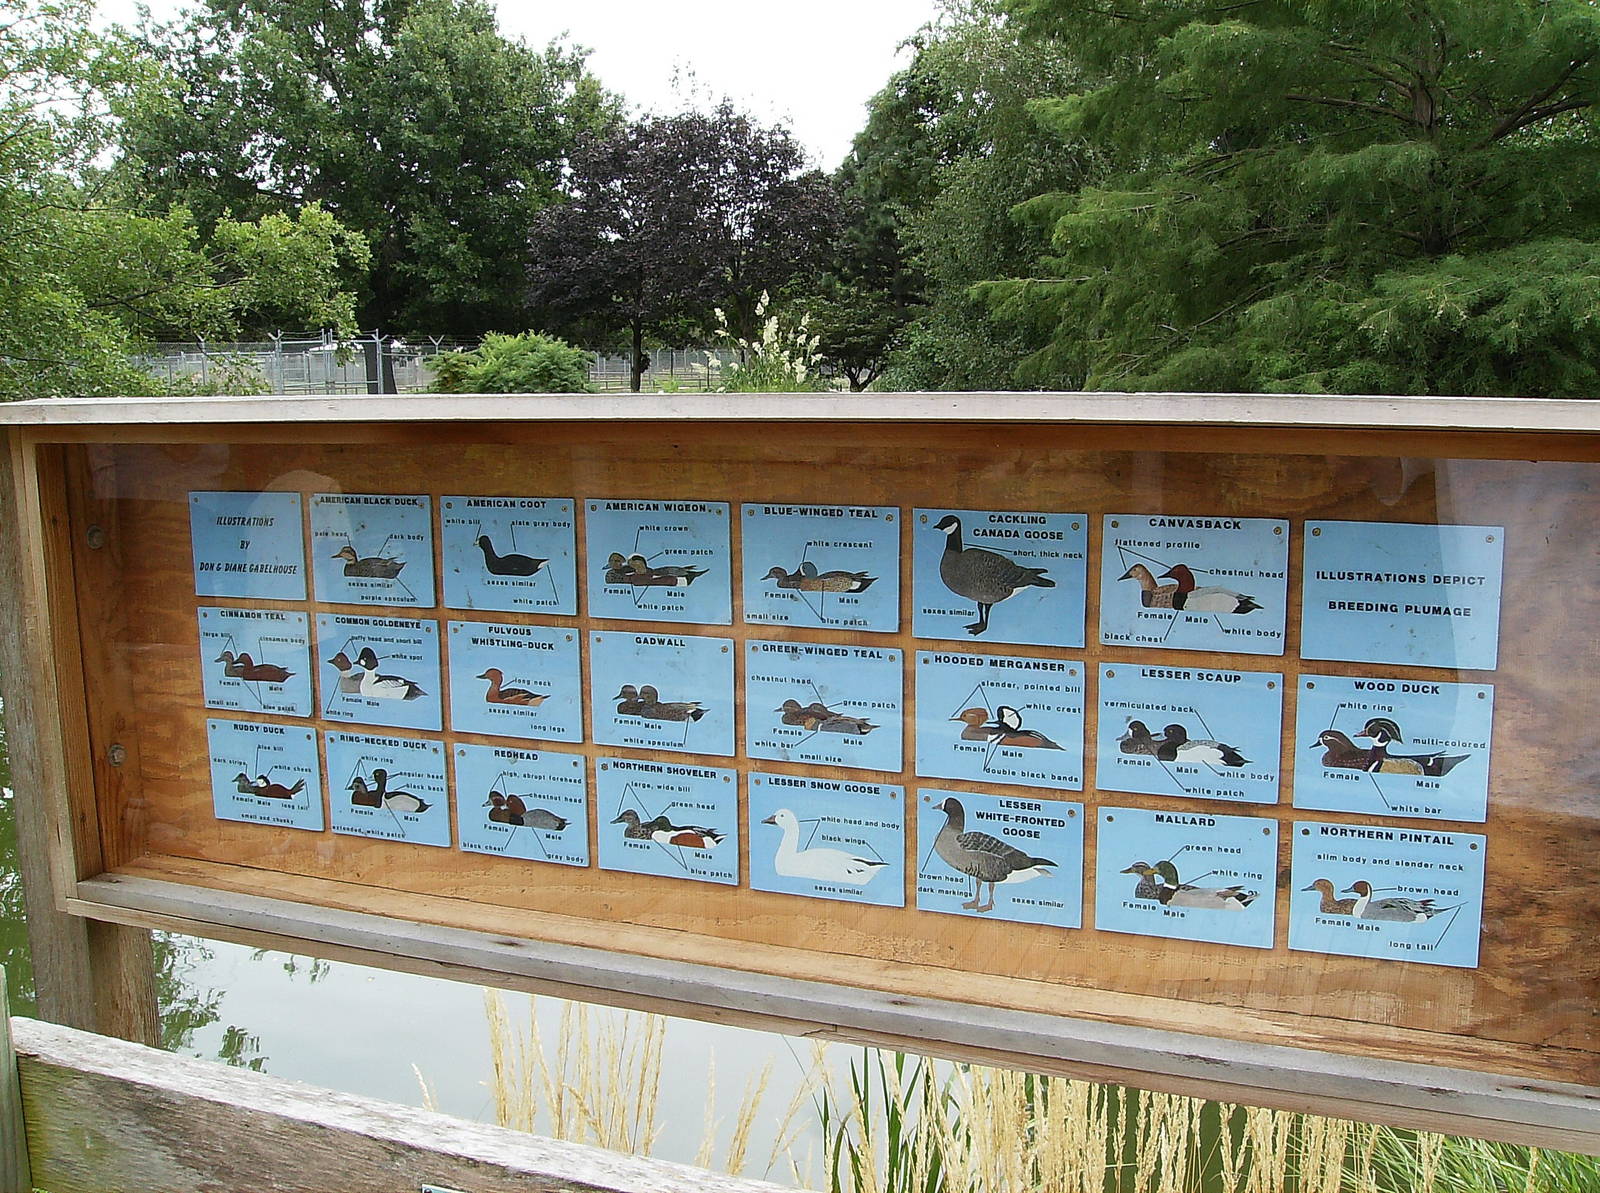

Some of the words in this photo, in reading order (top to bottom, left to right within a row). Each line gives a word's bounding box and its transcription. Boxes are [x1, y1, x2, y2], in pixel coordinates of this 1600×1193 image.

[320, 496, 361, 504] AMERICAN
[467, 500, 516, 508] AMERICAN
[520, 500, 546, 509] COOT
[606, 503, 659, 512] AMERICAN
[664, 504, 706, 512] WIGEON
[764, 507, 843, 517] BLUE-WINGED
[849, 509, 878, 518] TEAL
[216, 517, 274, 527] ILLUSTRATIONS
[989, 515, 1046, 524] CACKLING
[1149, 519, 1241, 530] CANVASBACK
[973, 529, 1020, 538] CANADA
[1025, 531, 1063, 540] GOOSE
[240, 541, 250, 549] BY
[1115, 539, 1161, 548] flattened
[1166, 540, 1200, 549] profile
[200, 562, 215, 571] DON
[225, 564, 247, 572] DIANE
[249, 564, 297, 574] GABELHOUSE
[1209, 568, 1253, 577] chestnut
[1259, 570, 1283, 578] head
[1316, 571, 1426, 584] ILLUSTRATIONS
[1433, 575, 1485, 585] DEPICT
[1328, 601, 1398, 613] BREEDING
[1405, 605, 1471, 617] PLUMAGE
[220, 611, 261, 619] CINNAMON
[265, 612, 285, 621] TEAL
[1138, 612, 1172, 620] Female
[1185, 616, 1208, 624] Male
[336, 617, 369, 626] COMMON
[373, 619, 421, 629] GOLDENEYE
[489, 627, 531, 636] FULVOUS
[1224, 628, 1251, 636] white
[1257, 629, 1281, 638] body
[636, 637, 685, 647] GADWALL
[1105, 633, 1130, 641] black
[1136, 634, 1163, 643] chest
[472, 638, 554, 650] WHISTLING-DUCK
[762, 644, 848, 657] GREEN-WINGED
[854, 650, 882, 659] TEAL
[935, 655, 983, 666] HOODED
[990, 660, 1065, 672] MERGANSER
[751, 675, 787, 683] chestnut
[1142, 669, 1190, 680] LESSER
[1197, 673, 1241, 683] SCAUP
[981, 681, 1020, 690] slender,
[1024, 683, 1060, 692] pointed
[1065, 685, 1081, 693] bill
[1354, 681, 1395, 692] WOOD
[1402, 683, 1440, 694] DUCK
[843, 700, 867, 708] green
[872, 701, 896, 709] patch
[1105, 700, 1167, 711] vermiculated
[1171, 705, 1194, 713] back
[1340, 702, 1368, 710] white
[1373, 703, 1393, 712] ring
[1057, 706, 1081, 714] crest
[614, 718, 641, 726] Female
[644, 722, 662, 730] Male
[234, 724, 259, 732] RUDDY
[263, 726, 284, 734] DUCK
[773, 728, 802, 737] Female
[340, 735, 399, 747] RING-NECKED
[403, 740, 427, 750] DUCK
[844, 738, 863, 746] Male
[1413, 737, 1486, 749] multi-colored
[954, 744, 985, 753] Female
[494, 750, 538, 761] REDHEAD
[1002, 750, 1023, 758] Male
[1117, 757, 1151, 767] Female
[613, 762, 663, 774] NORTHERN
[667, 766, 716, 779] SHOVELER
[986, 767, 1016, 776] double
[1021, 770, 1045, 779] black
[1052, 774, 1078, 782] bands
[1176, 766, 1198, 774] Male
[1219, 771, 1245, 779] white
[1251, 772, 1275, 782] body
[1323, 771, 1360, 781] Female
[769, 778, 806, 788] LESSER
[811, 781, 840, 791] SNOW
[845, 785, 880, 795] GOOSE
[1416, 780, 1440, 789] Male
[1216, 788, 1244, 797] patch
[1000, 800, 1041, 811] LESSER
[1391, 805, 1419, 813] white
[1424, 806, 1442, 815] bar
[844, 817, 862, 825] head
[882, 822, 900, 830] body
[976, 812, 1065, 827] WHITE-FRONTED
[1156, 814, 1216, 826] MALLARD
[484, 824, 509, 833] Female
[1003, 828, 1040, 838] GOOSE
[546, 833, 562, 841] Male
[845, 837, 866, 845] wings
[1321, 827, 1394, 841] NORTHERN
[1400, 833, 1454, 845] PINTAIL
[624, 841, 650, 850] Female
[1185, 844, 1212, 852] green
[1218, 846, 1241, 854] head
[695, 852, 713, 860] Male
[1317, 853, 1338, 861] slim
[1343, 856, 1367, 865] body
[1395, 860, 1433, 869] slender
[1438, 862, 1464, 871] neck
[690, 868, 707, 876] blue
[710, 869, 733, 879] patch
[919, 873, 942, 881] brown
[1212, 869, 1238, 877] white
[1243, 871, 1262, 880] ring
[938, 889, 972, 898] markings
[1397, 885, 1429, 894] brown
[1434, 887, 1459, 896] head
[1039, 900, 1064, 908] similar
[1123, 901, 1156, 911] Female
[1164, 910, 1185, 918] Male
[1315, 917, 1351, 927] Female
[1357, 924, 1380, 932] Male
[1390, 940, 1411, 950] long
[1417, 943, 1433, 951] tail
